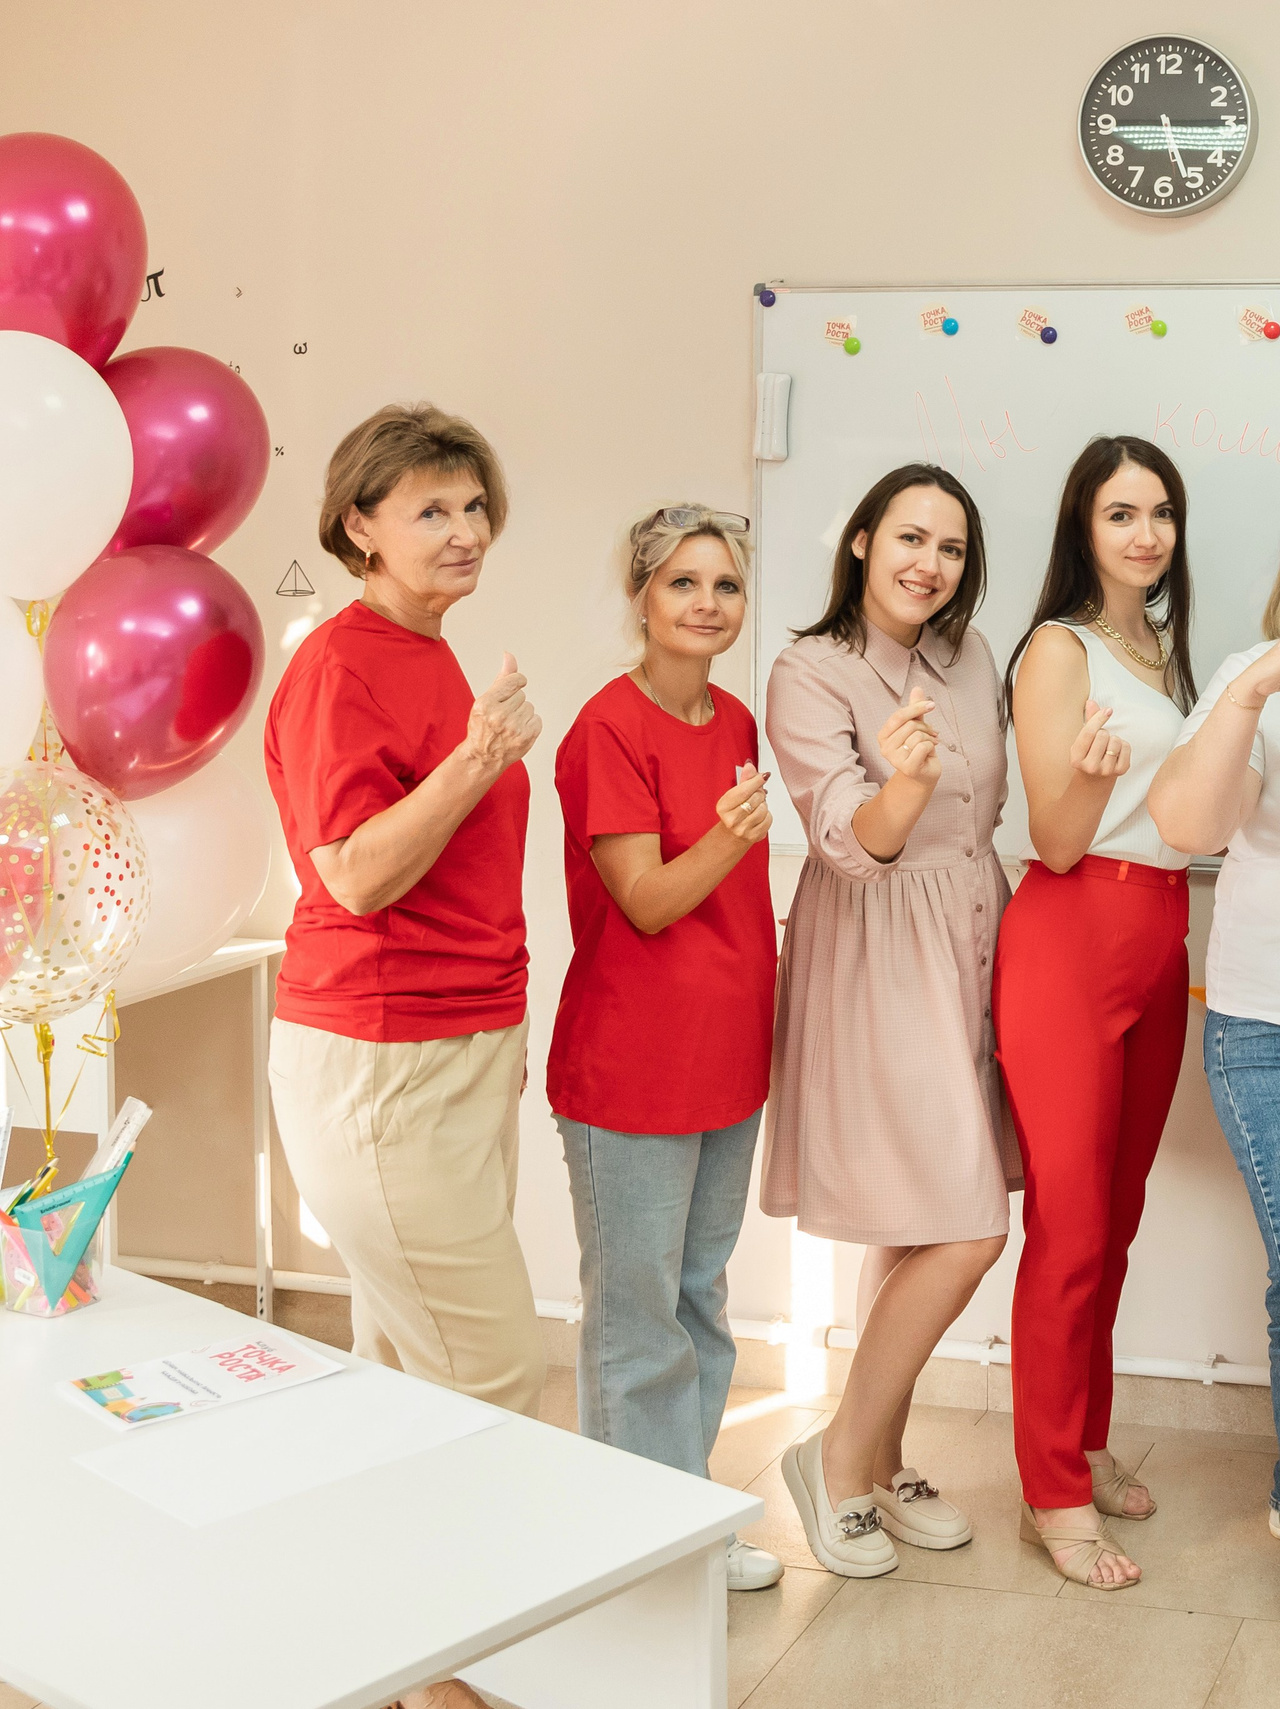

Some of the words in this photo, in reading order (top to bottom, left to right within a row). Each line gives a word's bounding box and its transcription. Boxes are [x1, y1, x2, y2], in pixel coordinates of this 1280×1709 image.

[1131, 63, 1150, 84] 11
[1156, 53, 1183, 75] 12
[1194, 63, 1205, 84] 1
[1107, 85, 1134, 106] 10
[1210, 86, 1228, 107] 2
[1097, 114, 1117, 135] 9
[1220, 115, 1237, 136] 3
[1106, 145, 1125, 166] 8
[1207, 149, 1226, 168] 4
[1128, 166, 1145, 188] 7
[1153, 176, 1174, 198] 6
[1185, 166, 1204, 188] 5
[921, 307, 946, 320] ТОЧКА
[1022, 309, 1048, 325] ТОЧКА
[1125, 306, 1150, 321] ТОЧКА
[1244, 309, 1269, 325] ТОЧКА
[827, 322, 851, 330] ТОЧКА
[208, 1351, 266, 1383] РОСТА
[233, 1343, 297, 1375] ТОЧКА
